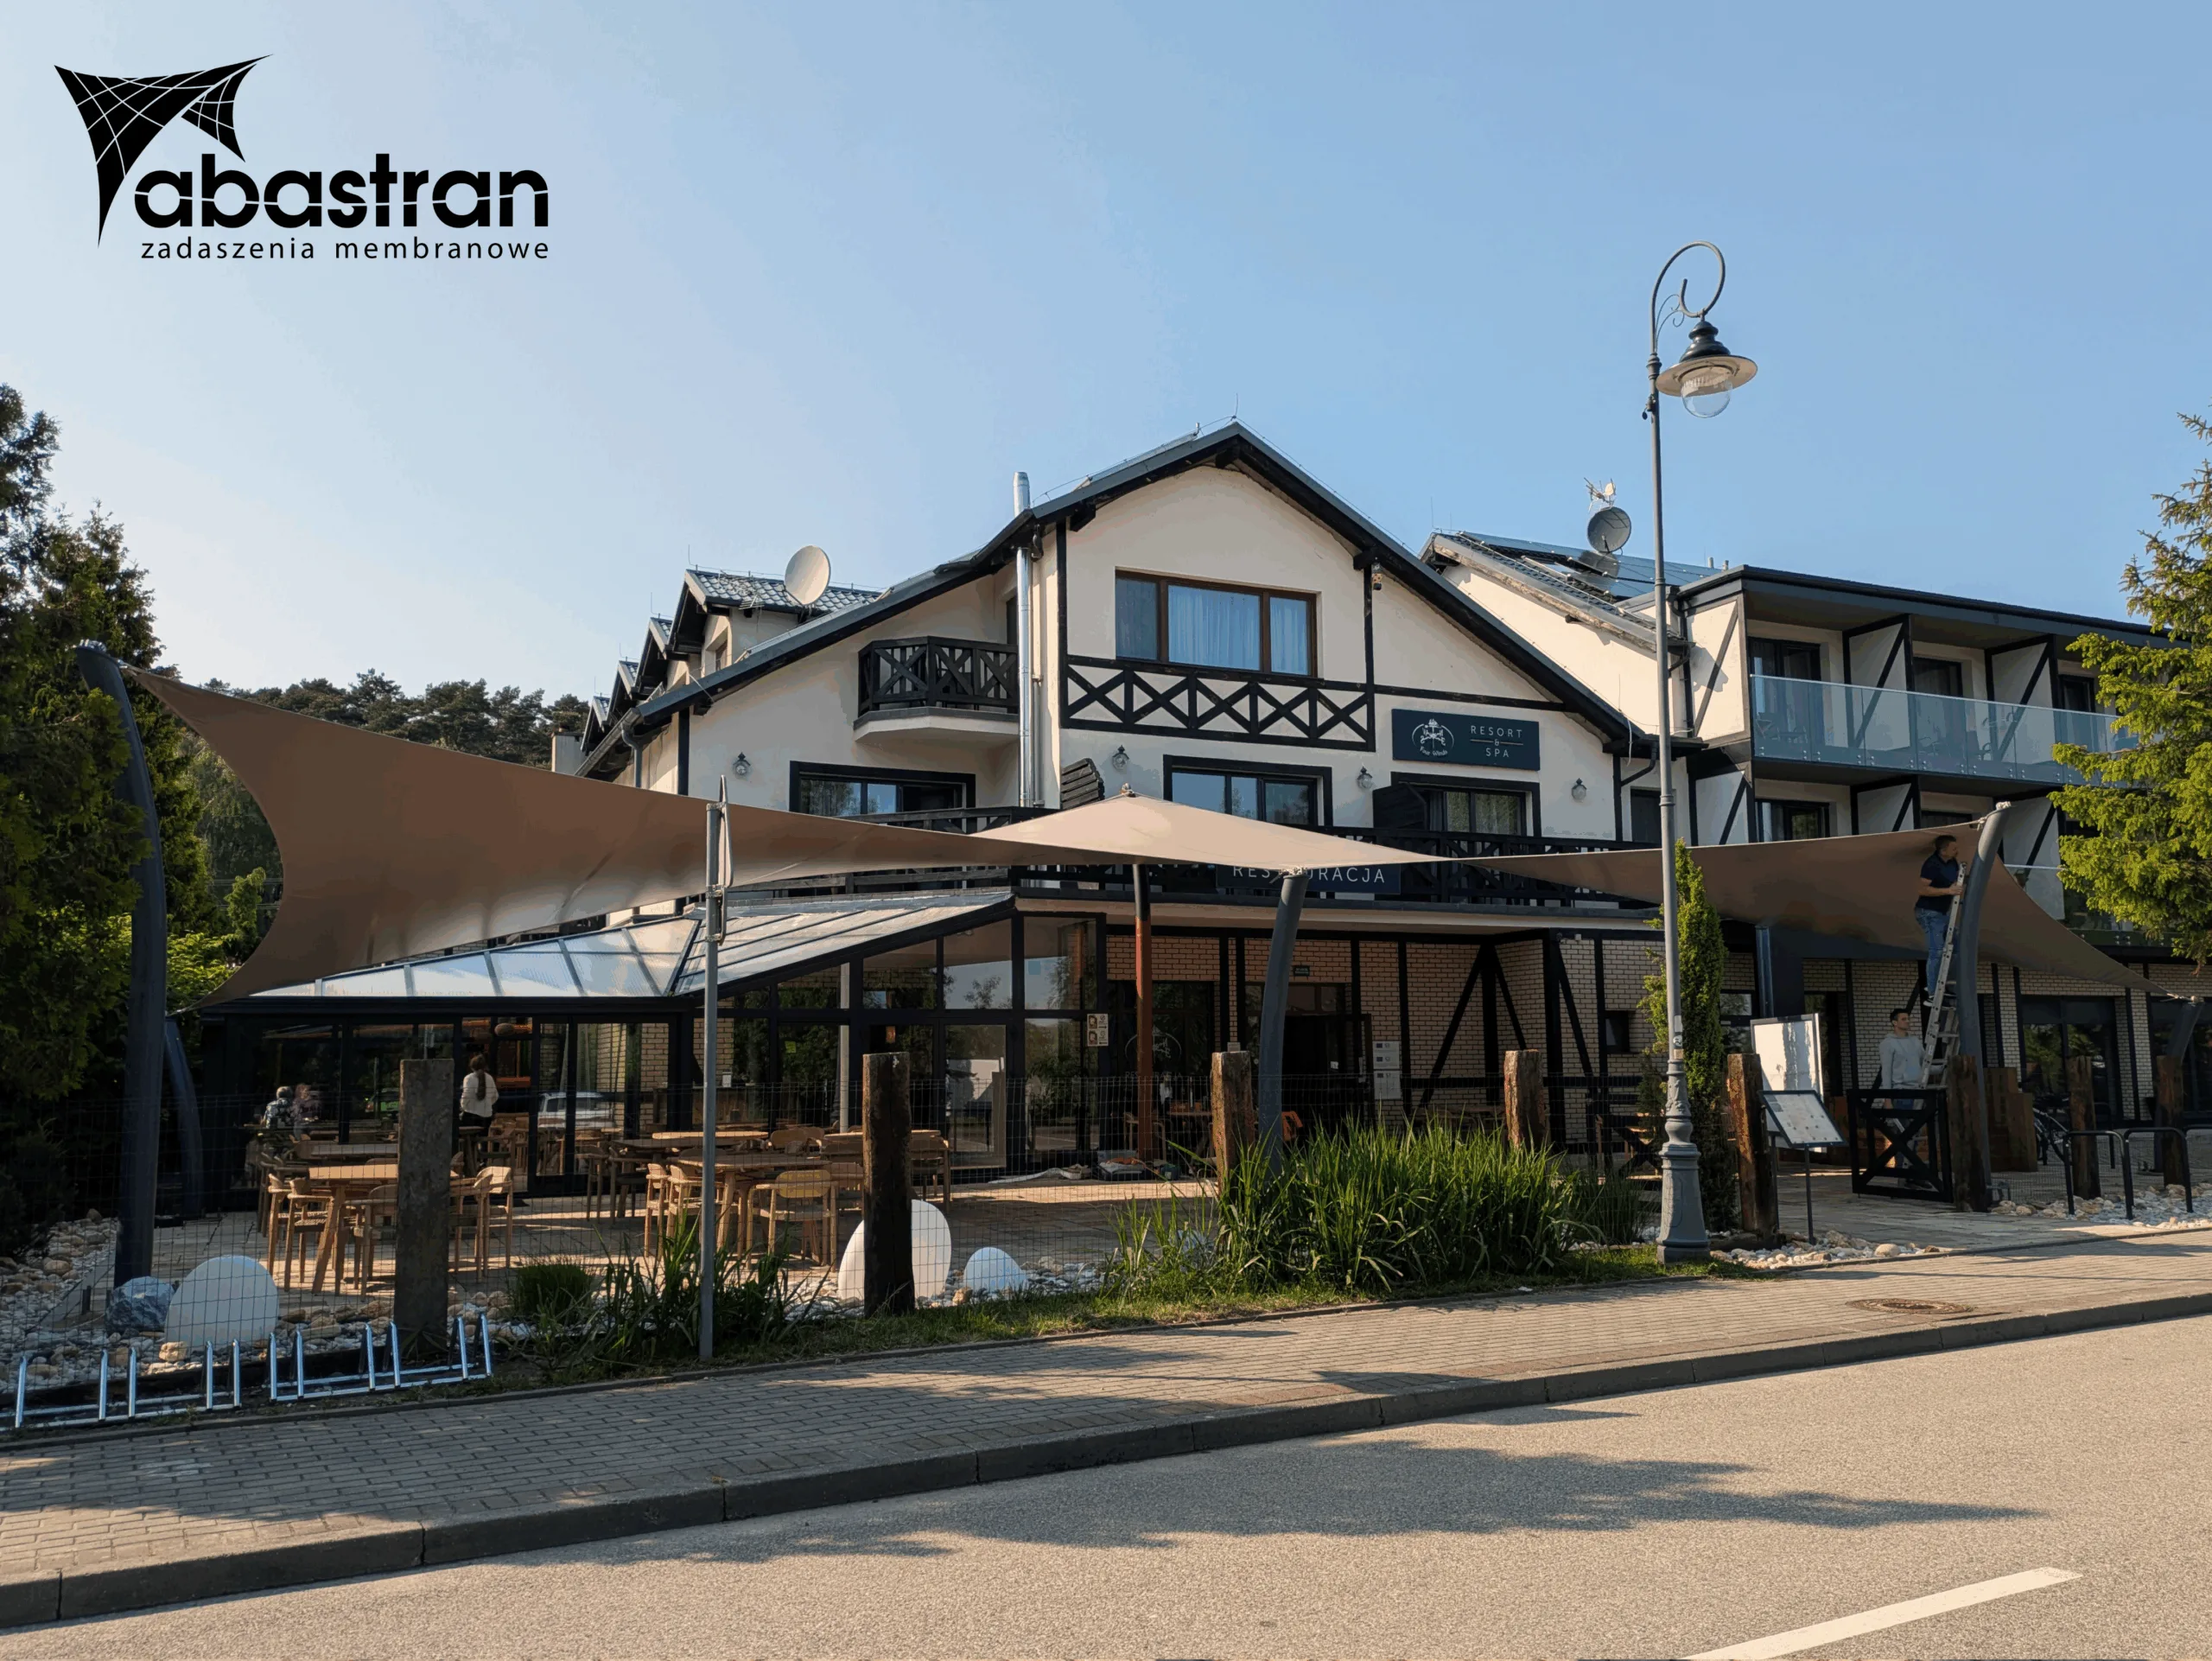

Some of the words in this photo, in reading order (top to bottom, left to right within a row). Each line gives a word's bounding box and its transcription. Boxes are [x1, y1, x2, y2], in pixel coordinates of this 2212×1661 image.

[1470, 725, 1522, 738] RESORT
[1485, 748, 1510, 758] SPA
[1233, 866, 1385, 883] RESRACJA
